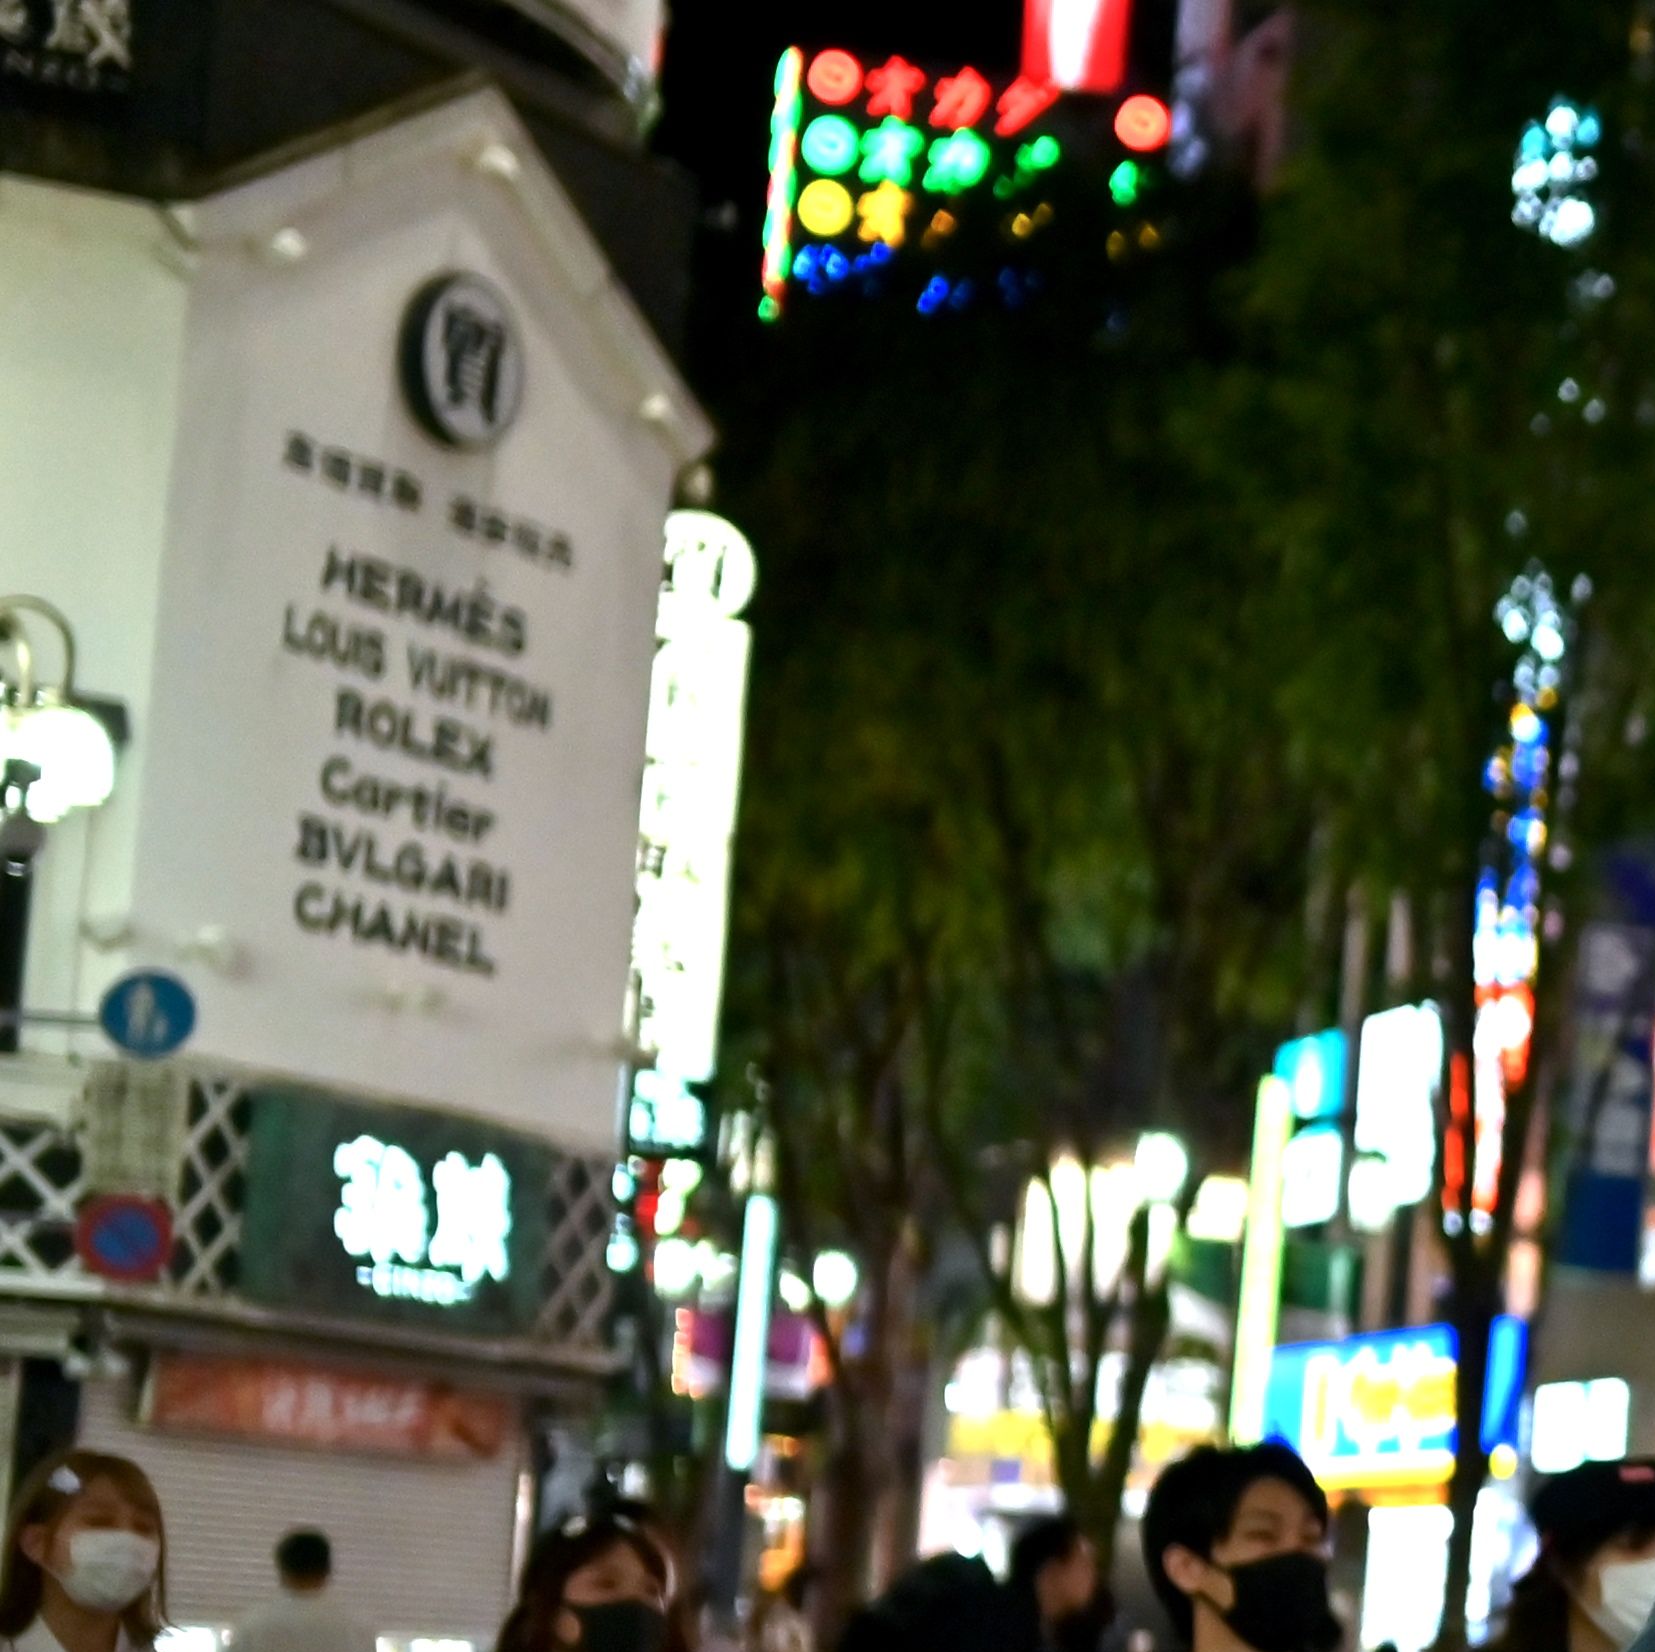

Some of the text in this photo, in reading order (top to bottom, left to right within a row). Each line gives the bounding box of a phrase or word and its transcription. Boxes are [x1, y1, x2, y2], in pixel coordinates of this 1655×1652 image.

[282, 600, 553, 731] LOUIS VUITTON
[334, 687, 495, 782] ROLEX
[319, 755, 496, 842] Cartier
[296, 811, 510, 915] BVLGARI
[292, 881, 496, 976] CHANEL
